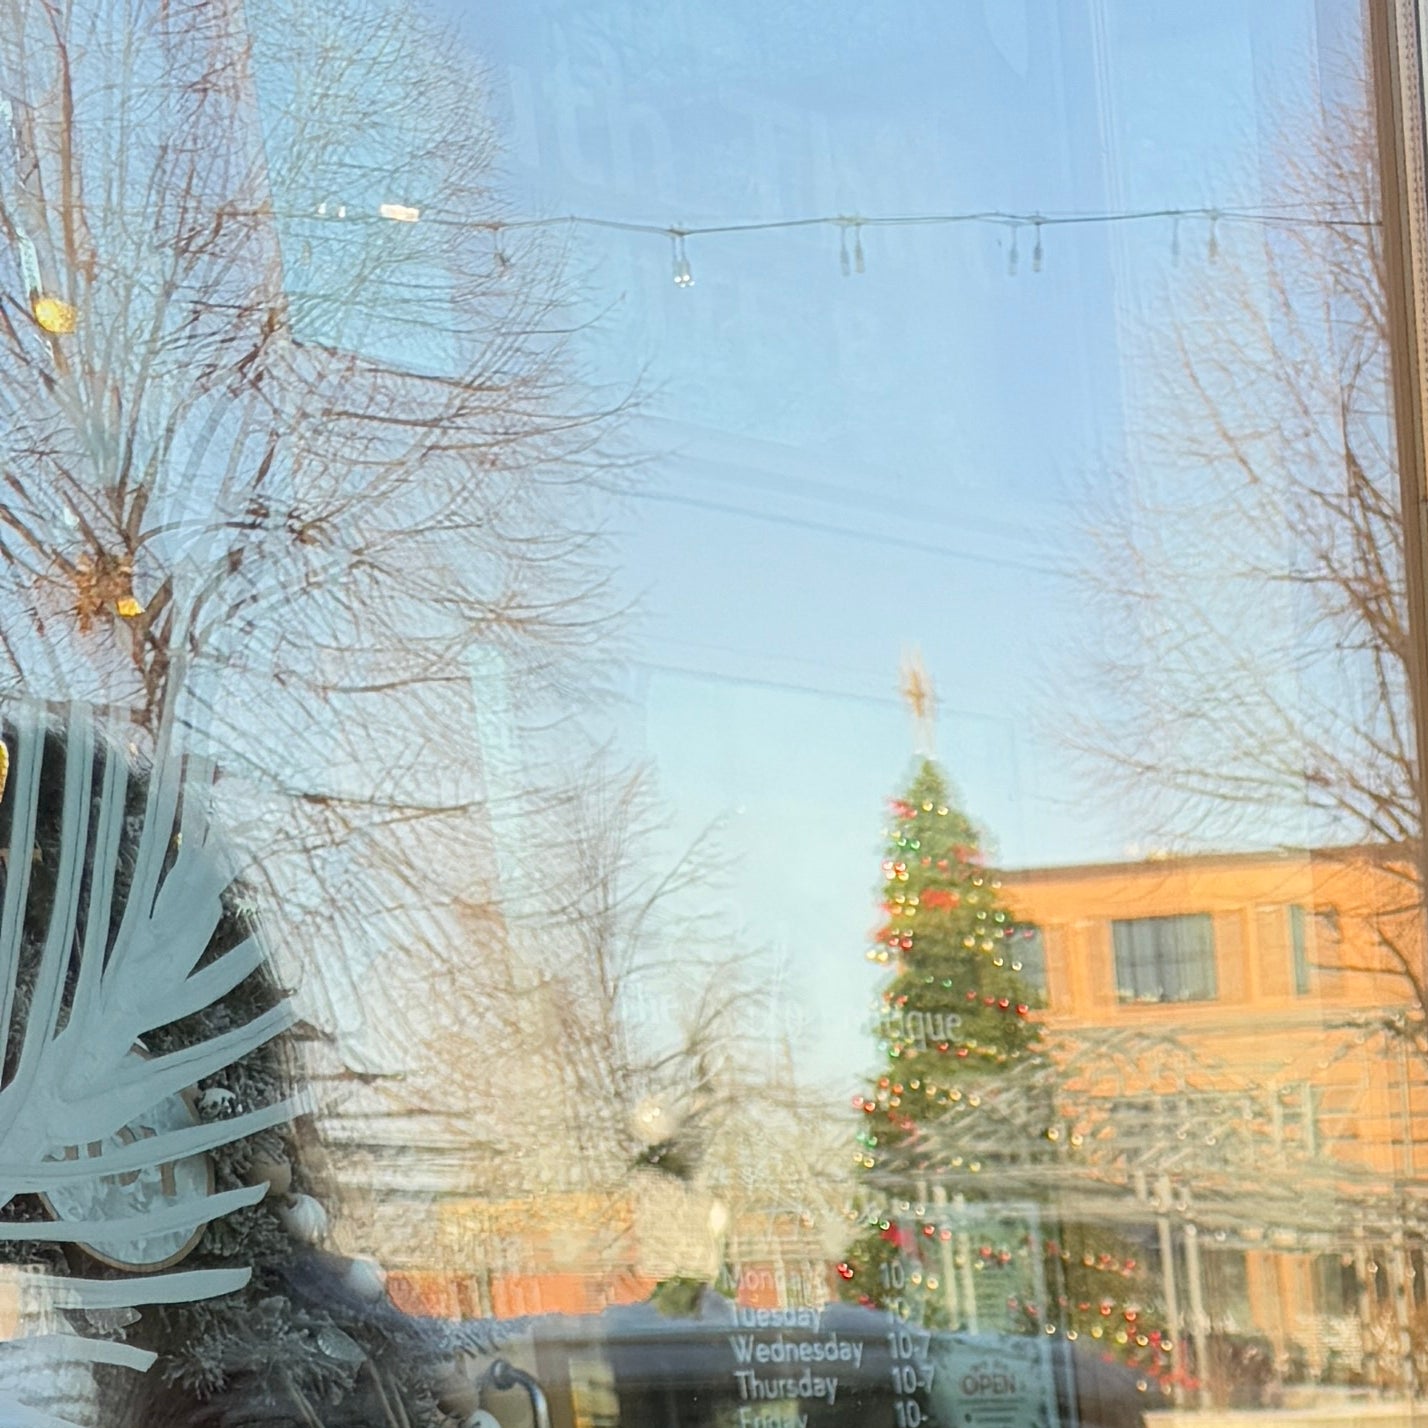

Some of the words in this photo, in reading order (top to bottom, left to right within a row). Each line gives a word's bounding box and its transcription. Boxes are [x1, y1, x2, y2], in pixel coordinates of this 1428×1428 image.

[730, 1302, 822, 1333] Tuesday
[728, 1332, 864, 1369] Wednesday
[888, 1331, 932, 1360] 10-7
[733, 1367, 839, 1406] Thursday
[891, 1364, 936, 1396] 10-7
